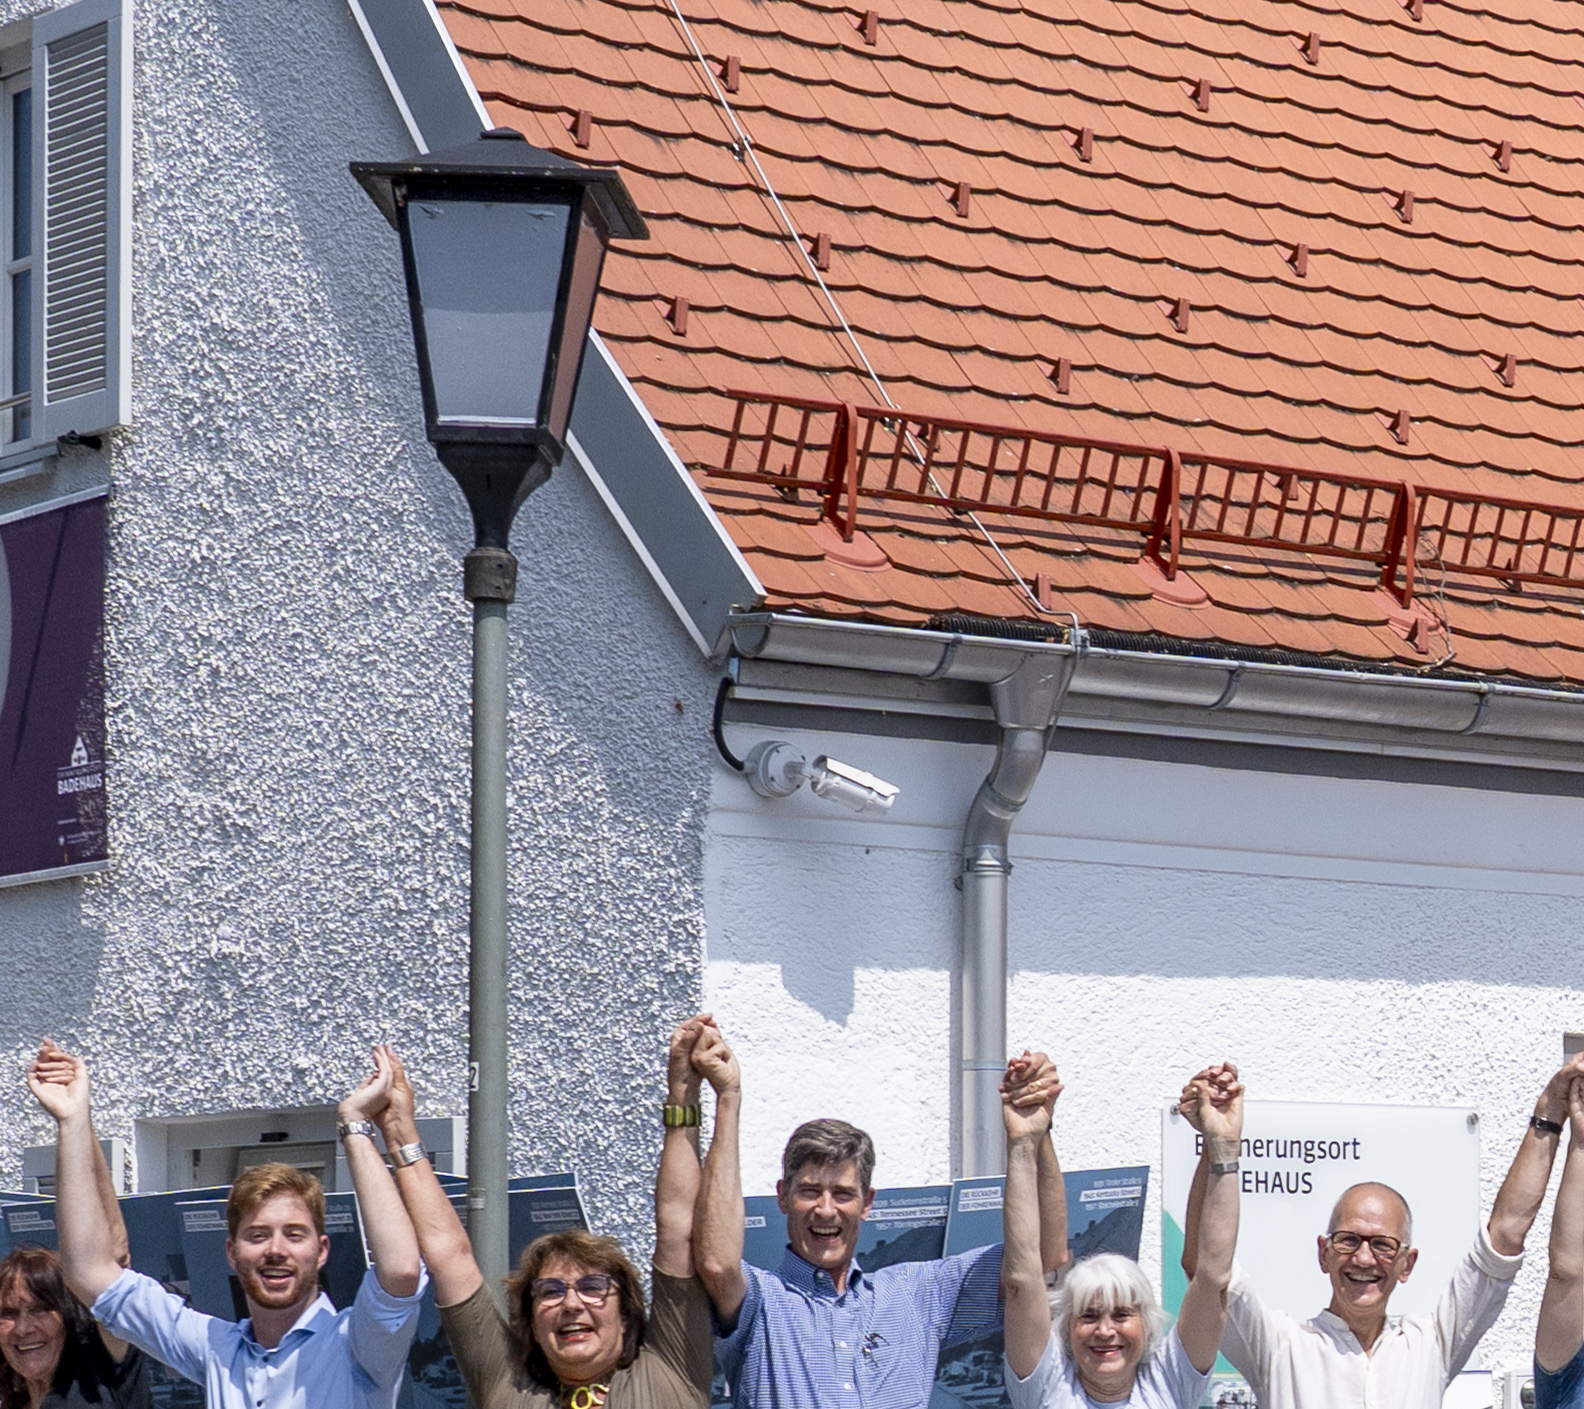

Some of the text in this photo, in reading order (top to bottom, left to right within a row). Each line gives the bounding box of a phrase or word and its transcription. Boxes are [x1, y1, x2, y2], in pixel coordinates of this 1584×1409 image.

[58, 773, 103, 795] BADEHAUS
[1195, 1133, 1361, 1164] Enerungsort
[1241, 1170, 1313, 1195] EHAUS
